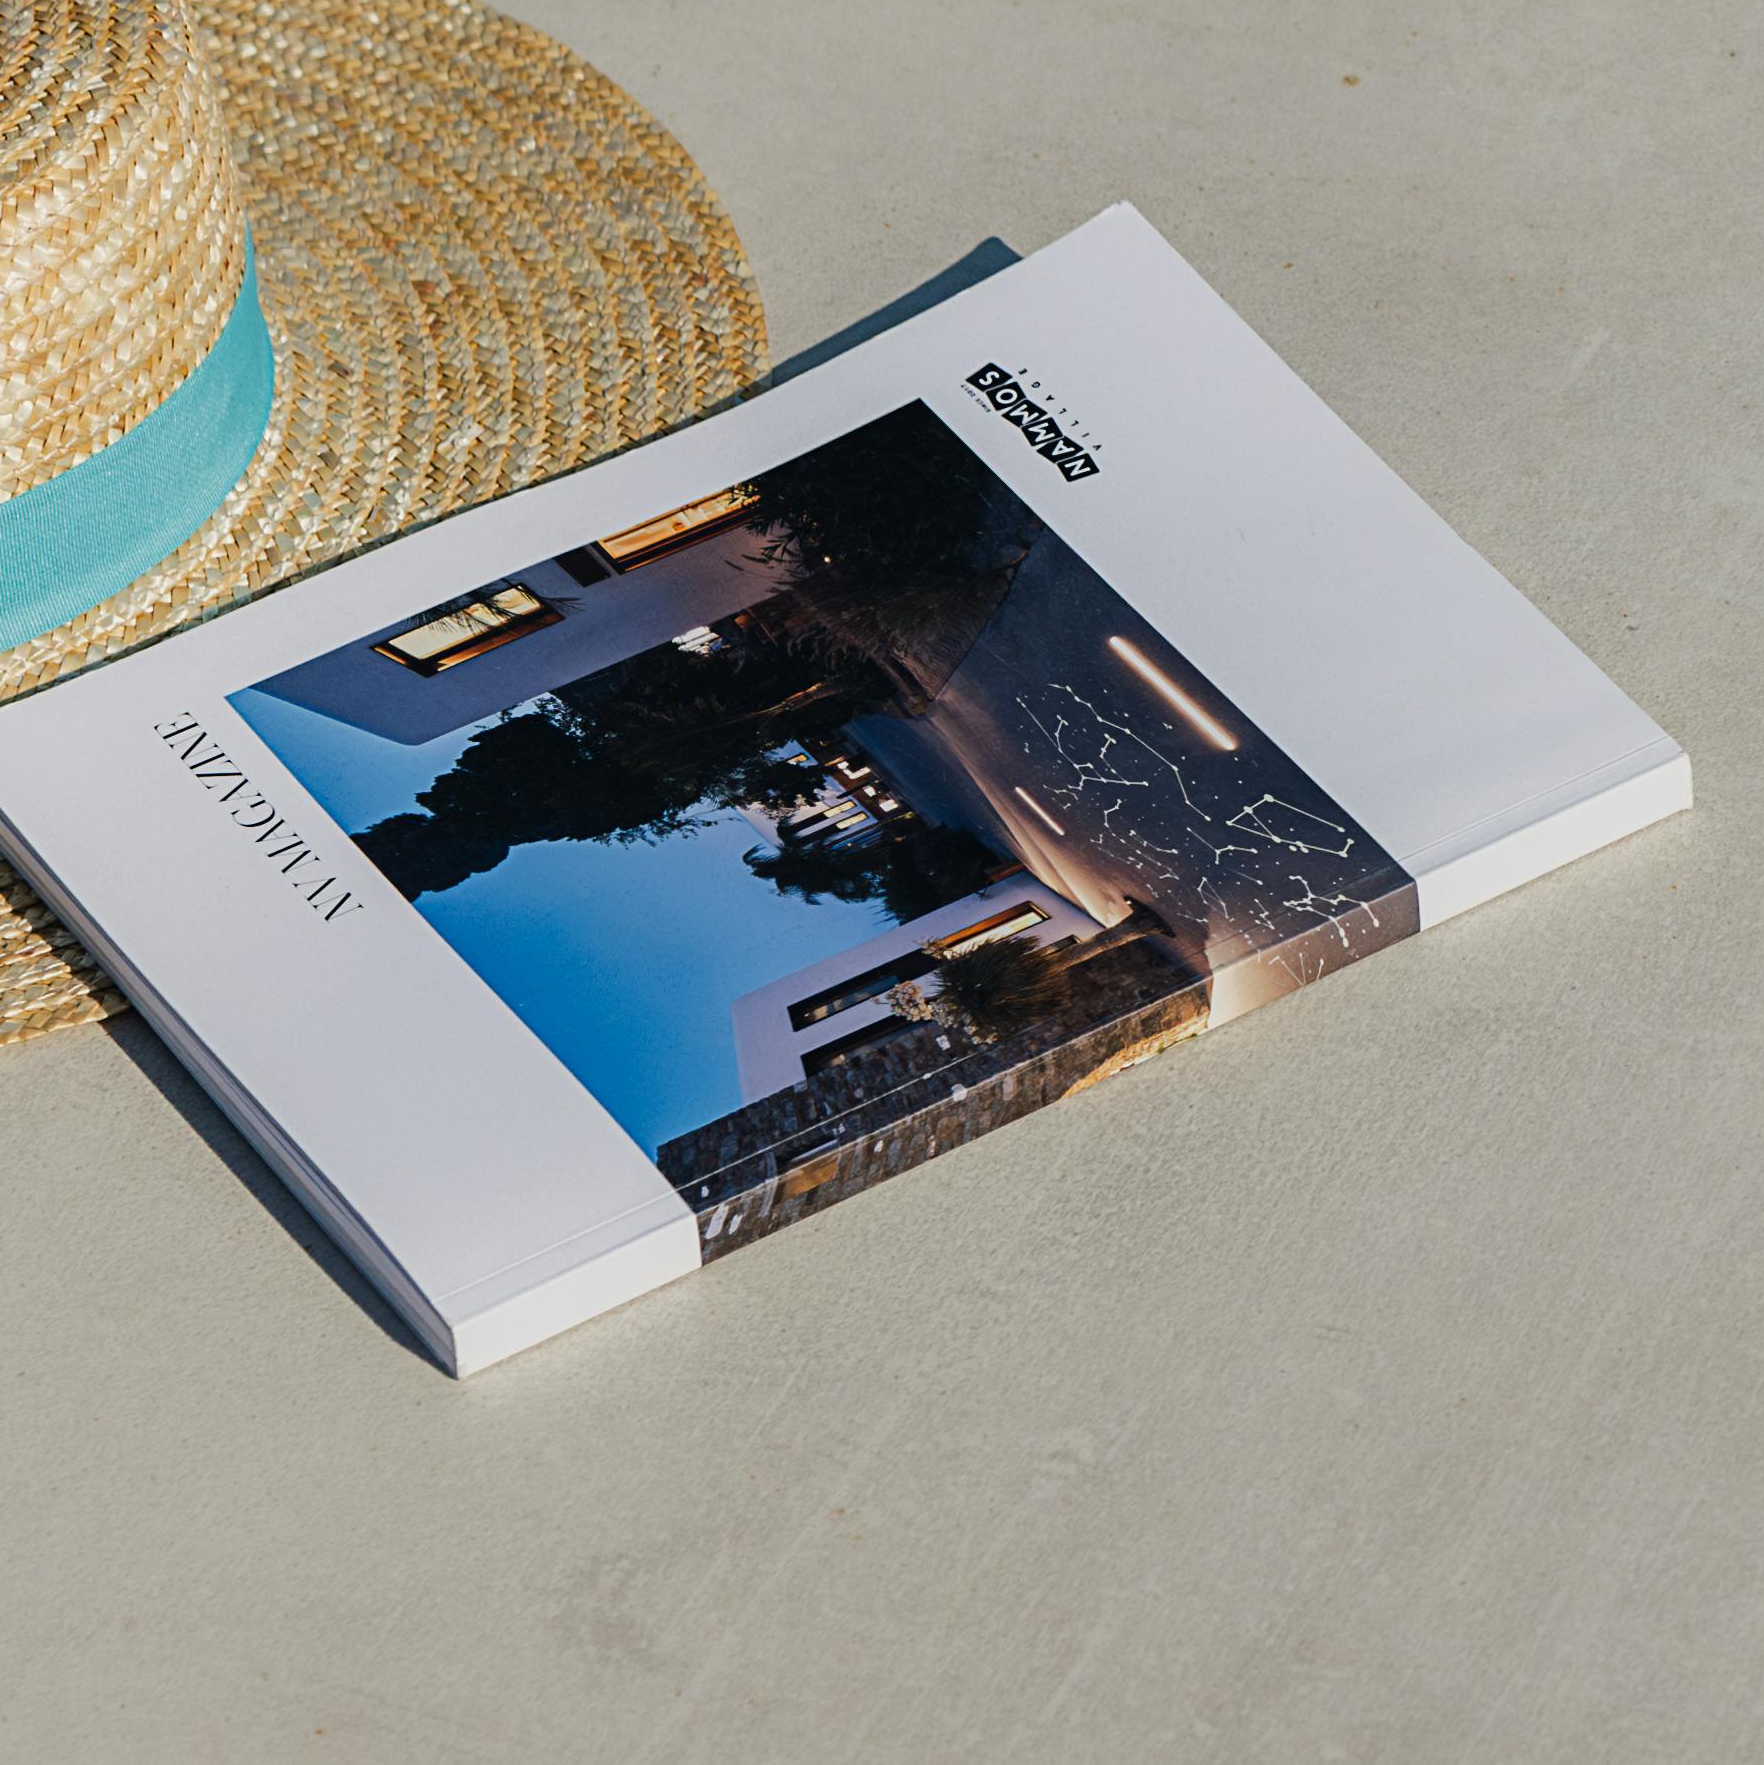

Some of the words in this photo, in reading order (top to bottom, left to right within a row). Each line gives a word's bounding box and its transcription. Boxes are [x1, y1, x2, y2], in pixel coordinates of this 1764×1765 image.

[971, 366, 1095, 479] NAMMOS
[1018, 367, 1103, 451] VILLAGE
[153, 712, 320, 874] MAGAZINE
[293, 877, 364, 922] NV
